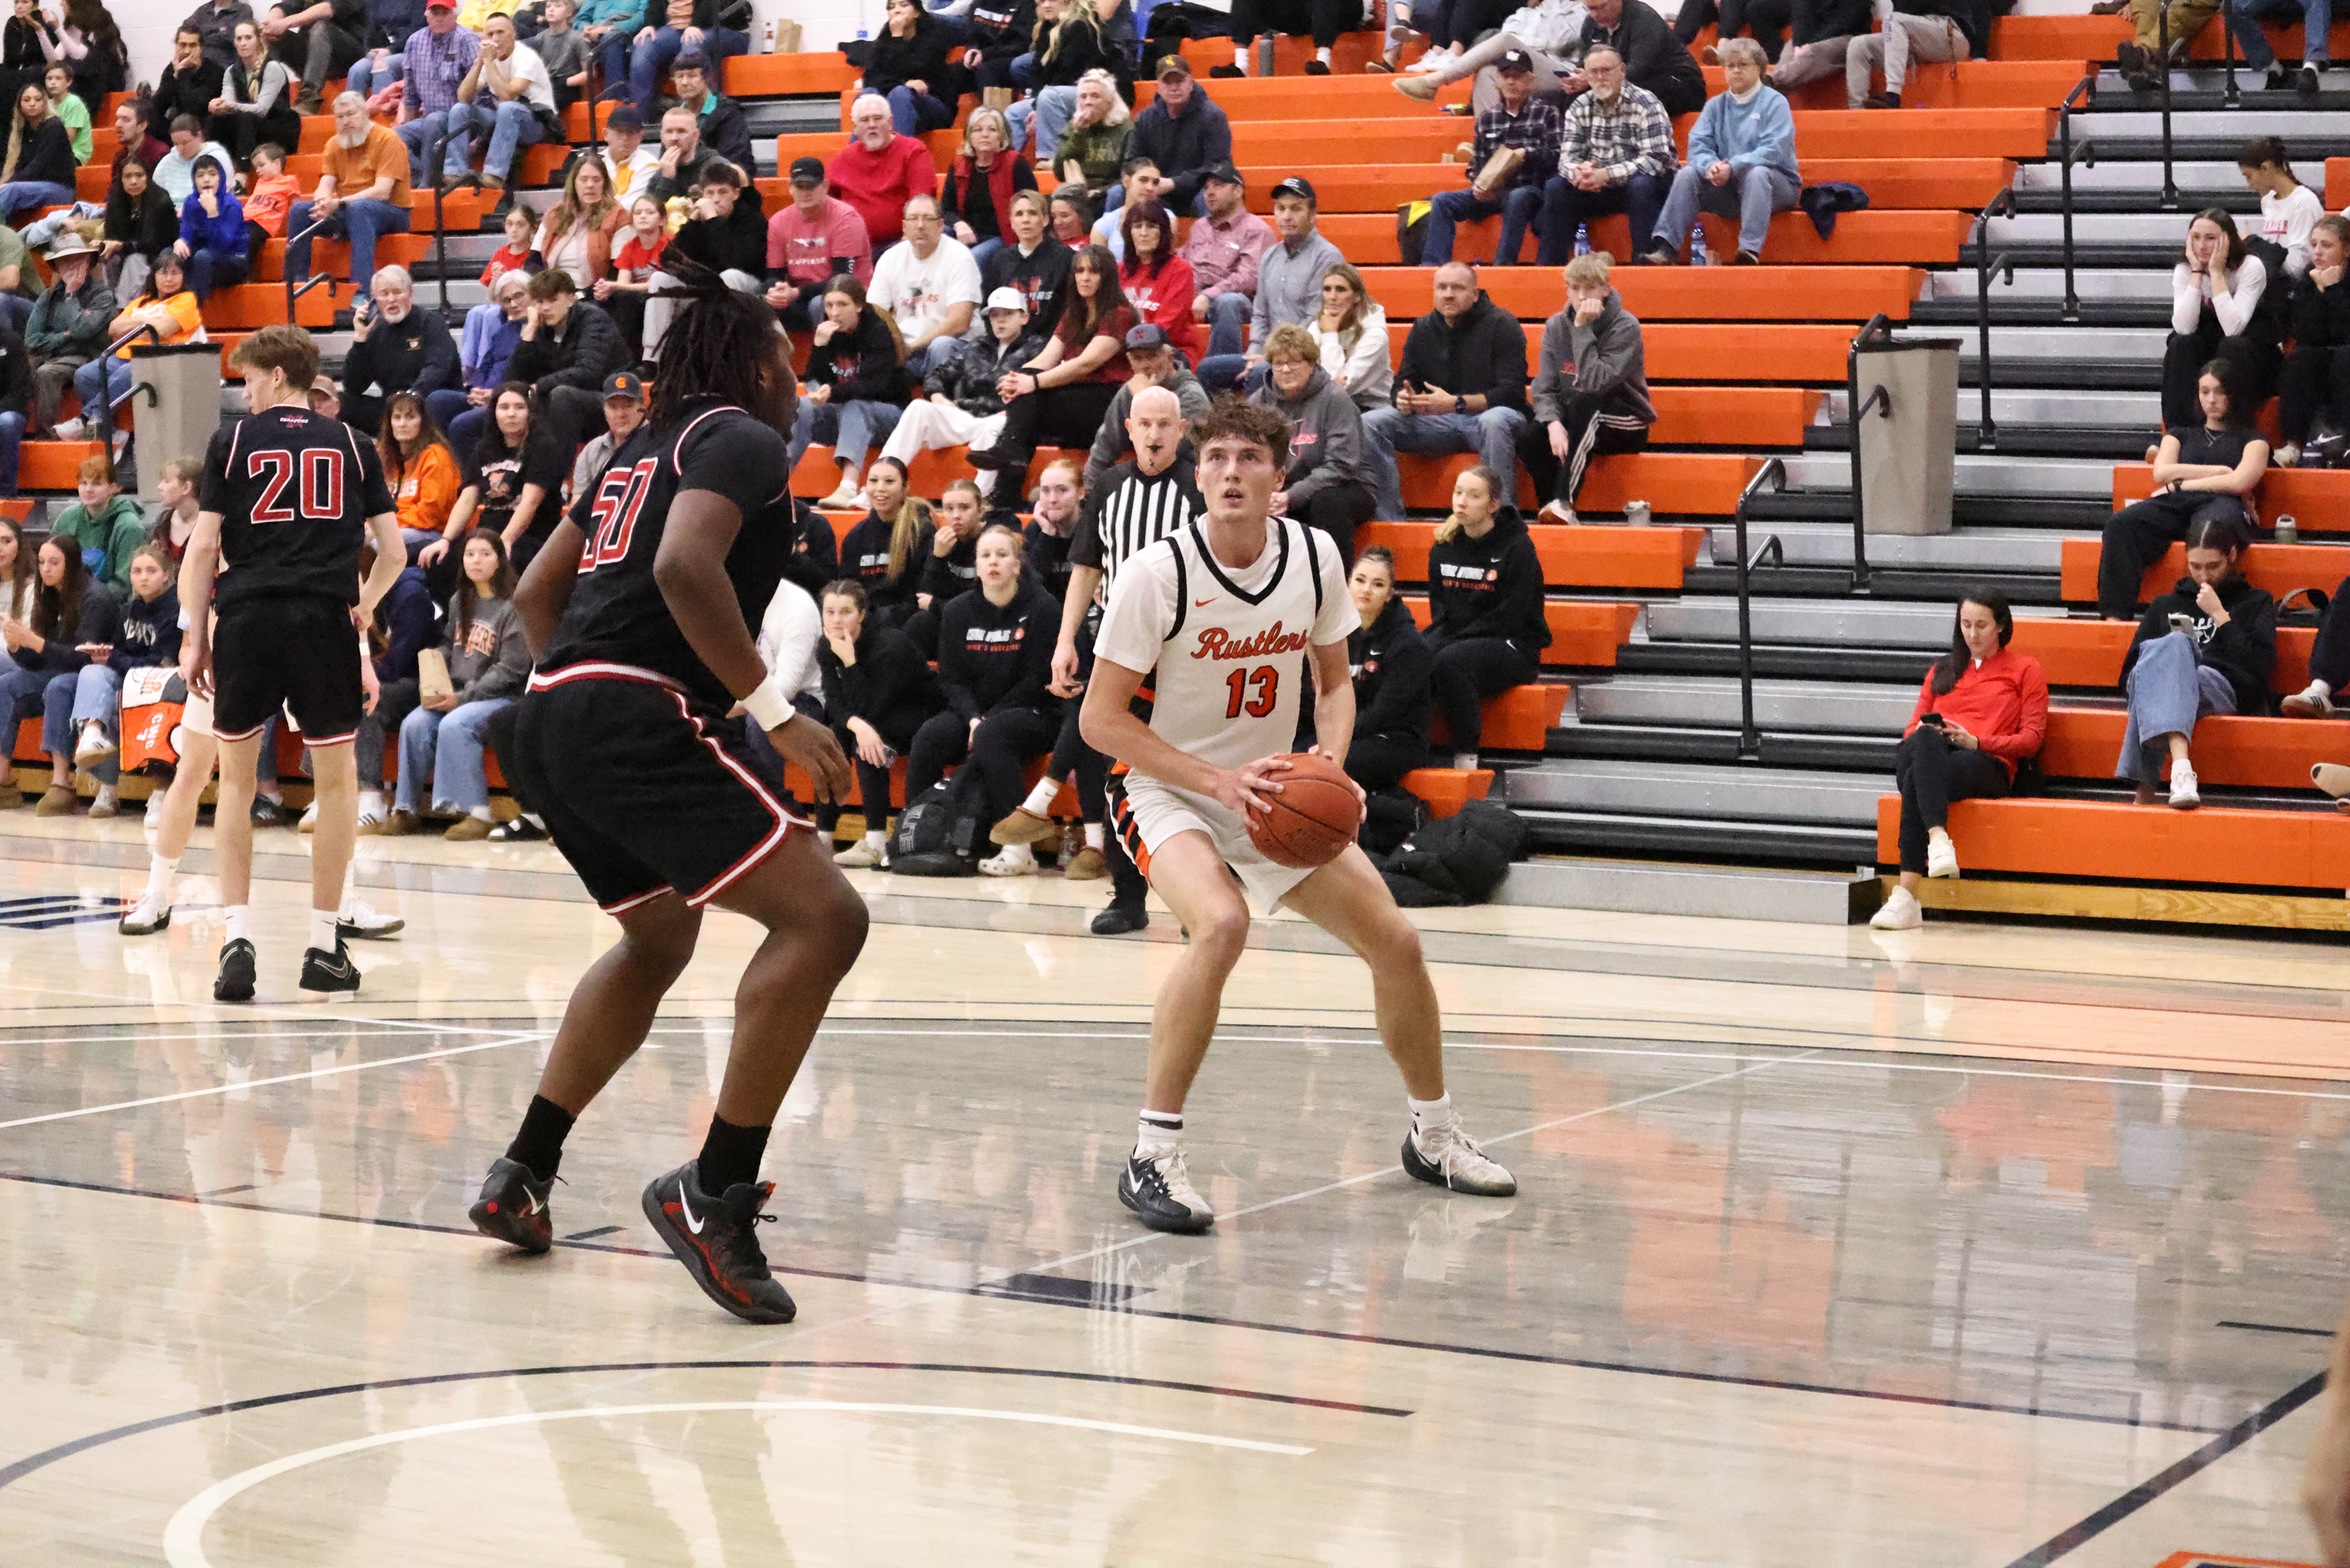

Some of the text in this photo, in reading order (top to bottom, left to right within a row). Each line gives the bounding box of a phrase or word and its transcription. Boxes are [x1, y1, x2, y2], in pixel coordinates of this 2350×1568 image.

[247, 447, 344, 524] 20
[577, 456, 659, 574] 50
[1190, 620, 1308, 660] Rustlers
[1225, 665, 1279, 719] 13
